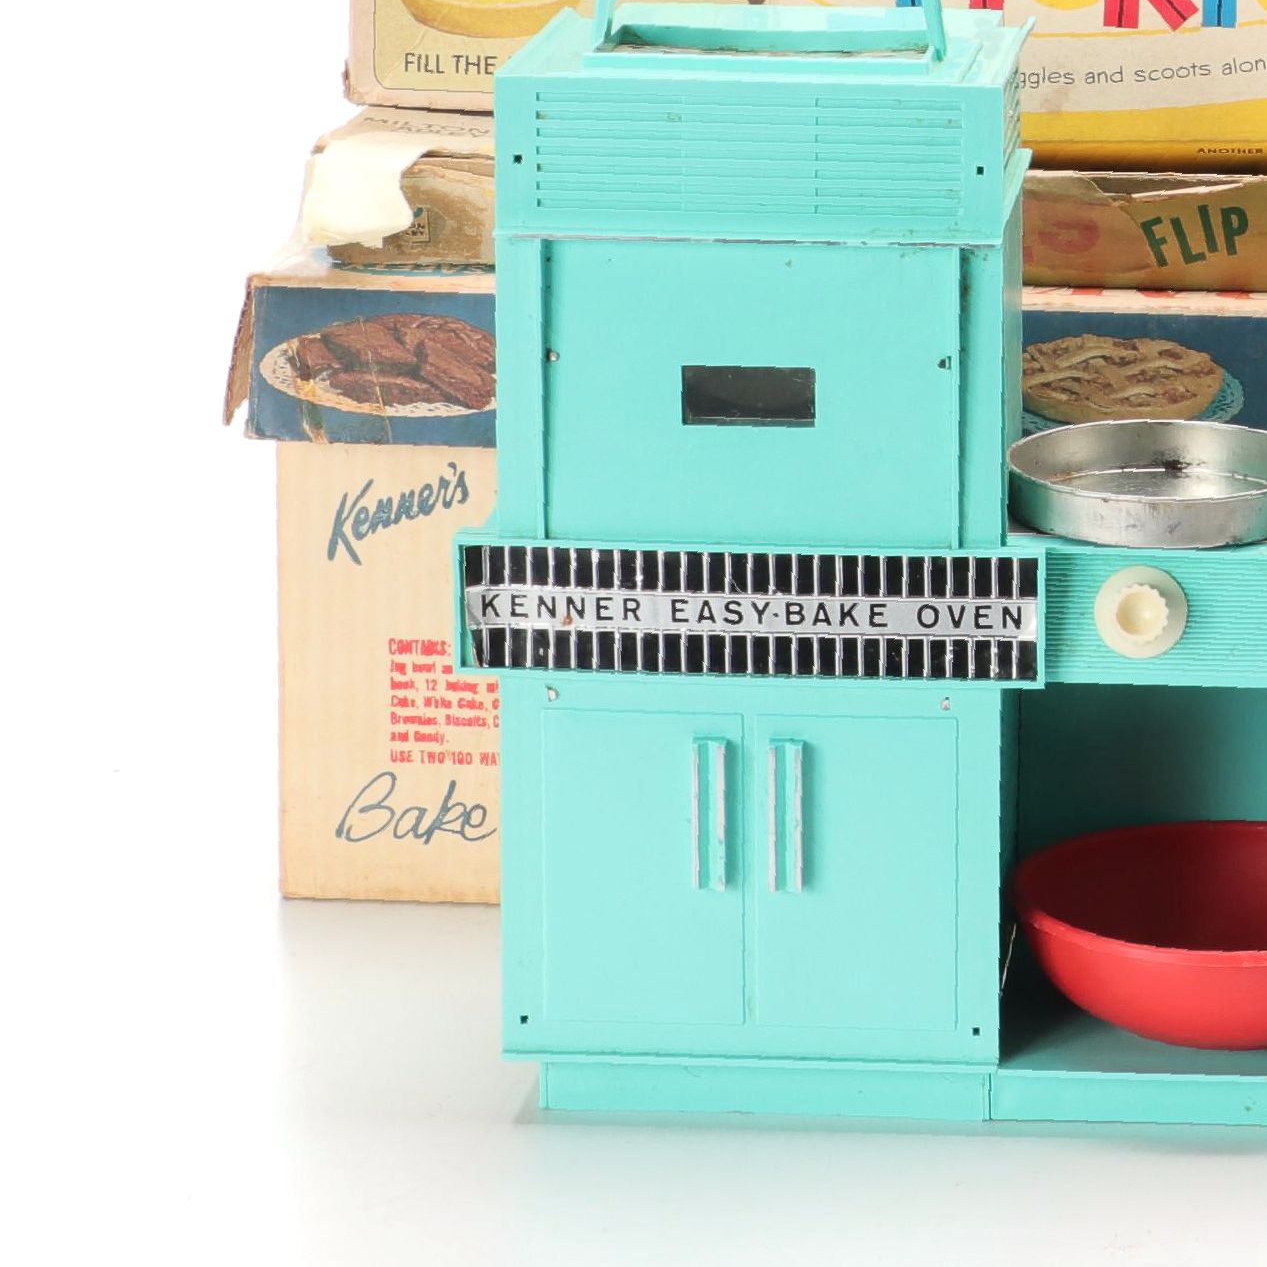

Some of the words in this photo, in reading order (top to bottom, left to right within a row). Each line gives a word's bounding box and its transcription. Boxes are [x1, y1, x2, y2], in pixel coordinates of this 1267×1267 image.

[403, 53, 445, 74] FILL
[451, 54, 497, 75] THE
[1085, 66, 1124, 84] and
[1133, 62, 1211, 83] scoots
[1197, 147, 1264, 155] ANOTHER
[1140, 204, 1248, 268] FLIP
[327, 461, 469, 566] Kenner's
[481, 593, 642, 621] KENNER
[671, 599, 889, 629] EASY-BAKE
[916, 604, 1024, 631] OVEN
[425, 679, 438, 691] 12
[390, 748, 414, 763] USE
[419, 749, 446, 764] TWO
[451, 751, 473, 765] 100
[335, 770, 498, 846] Bake
